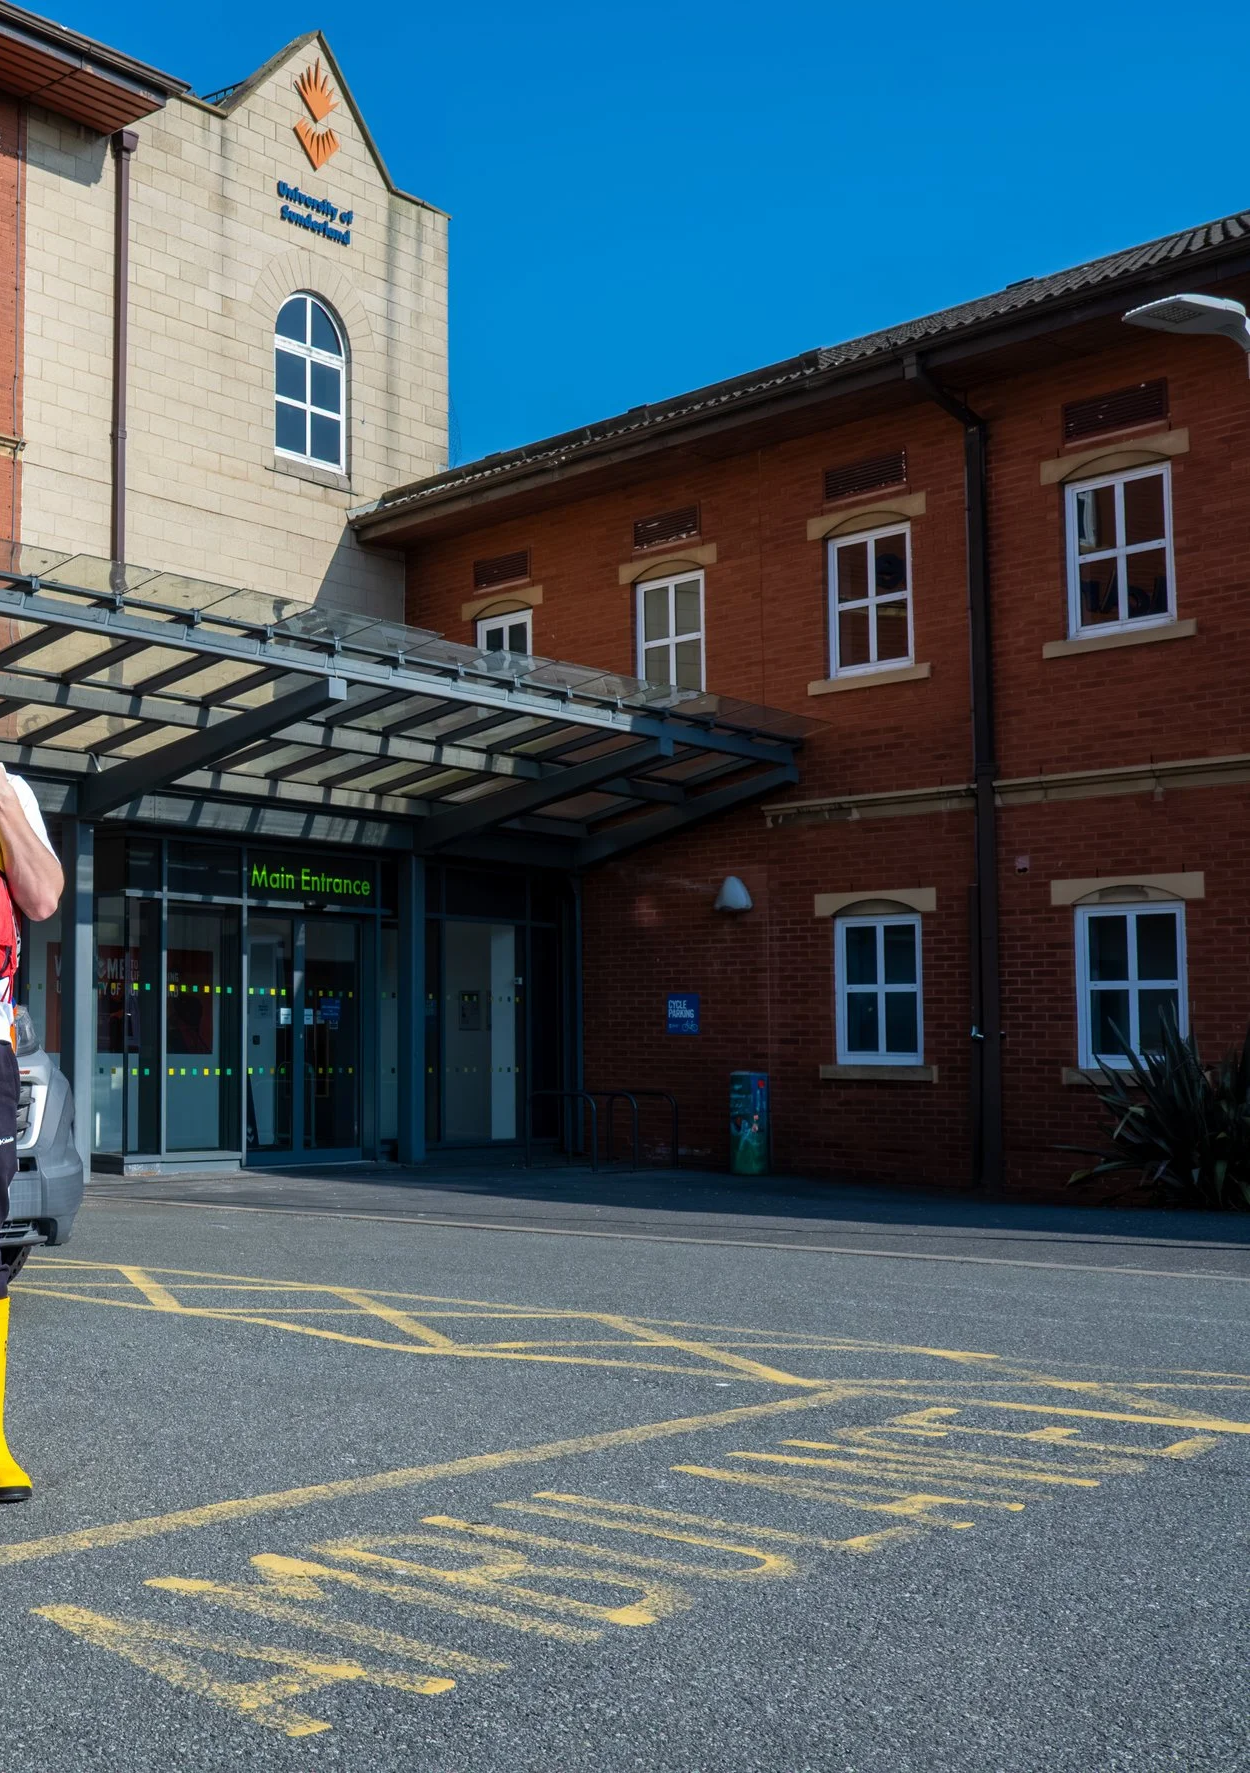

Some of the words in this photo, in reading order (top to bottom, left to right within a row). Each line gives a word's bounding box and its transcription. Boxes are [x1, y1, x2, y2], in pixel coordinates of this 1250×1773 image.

[277, 180, 338, 222] University
[339, 210, 354, 226] of
[280, 205, 350, 247] Sunderland
[251, 863, 295, 889] Main
[301, 868, 370, 895] Entrance
[668, 1000, 687, 1009] CYCLE
[668, 1009, 694, 1018] PARKING
[31, 1406, 1218, 1737] AMBULANCE
